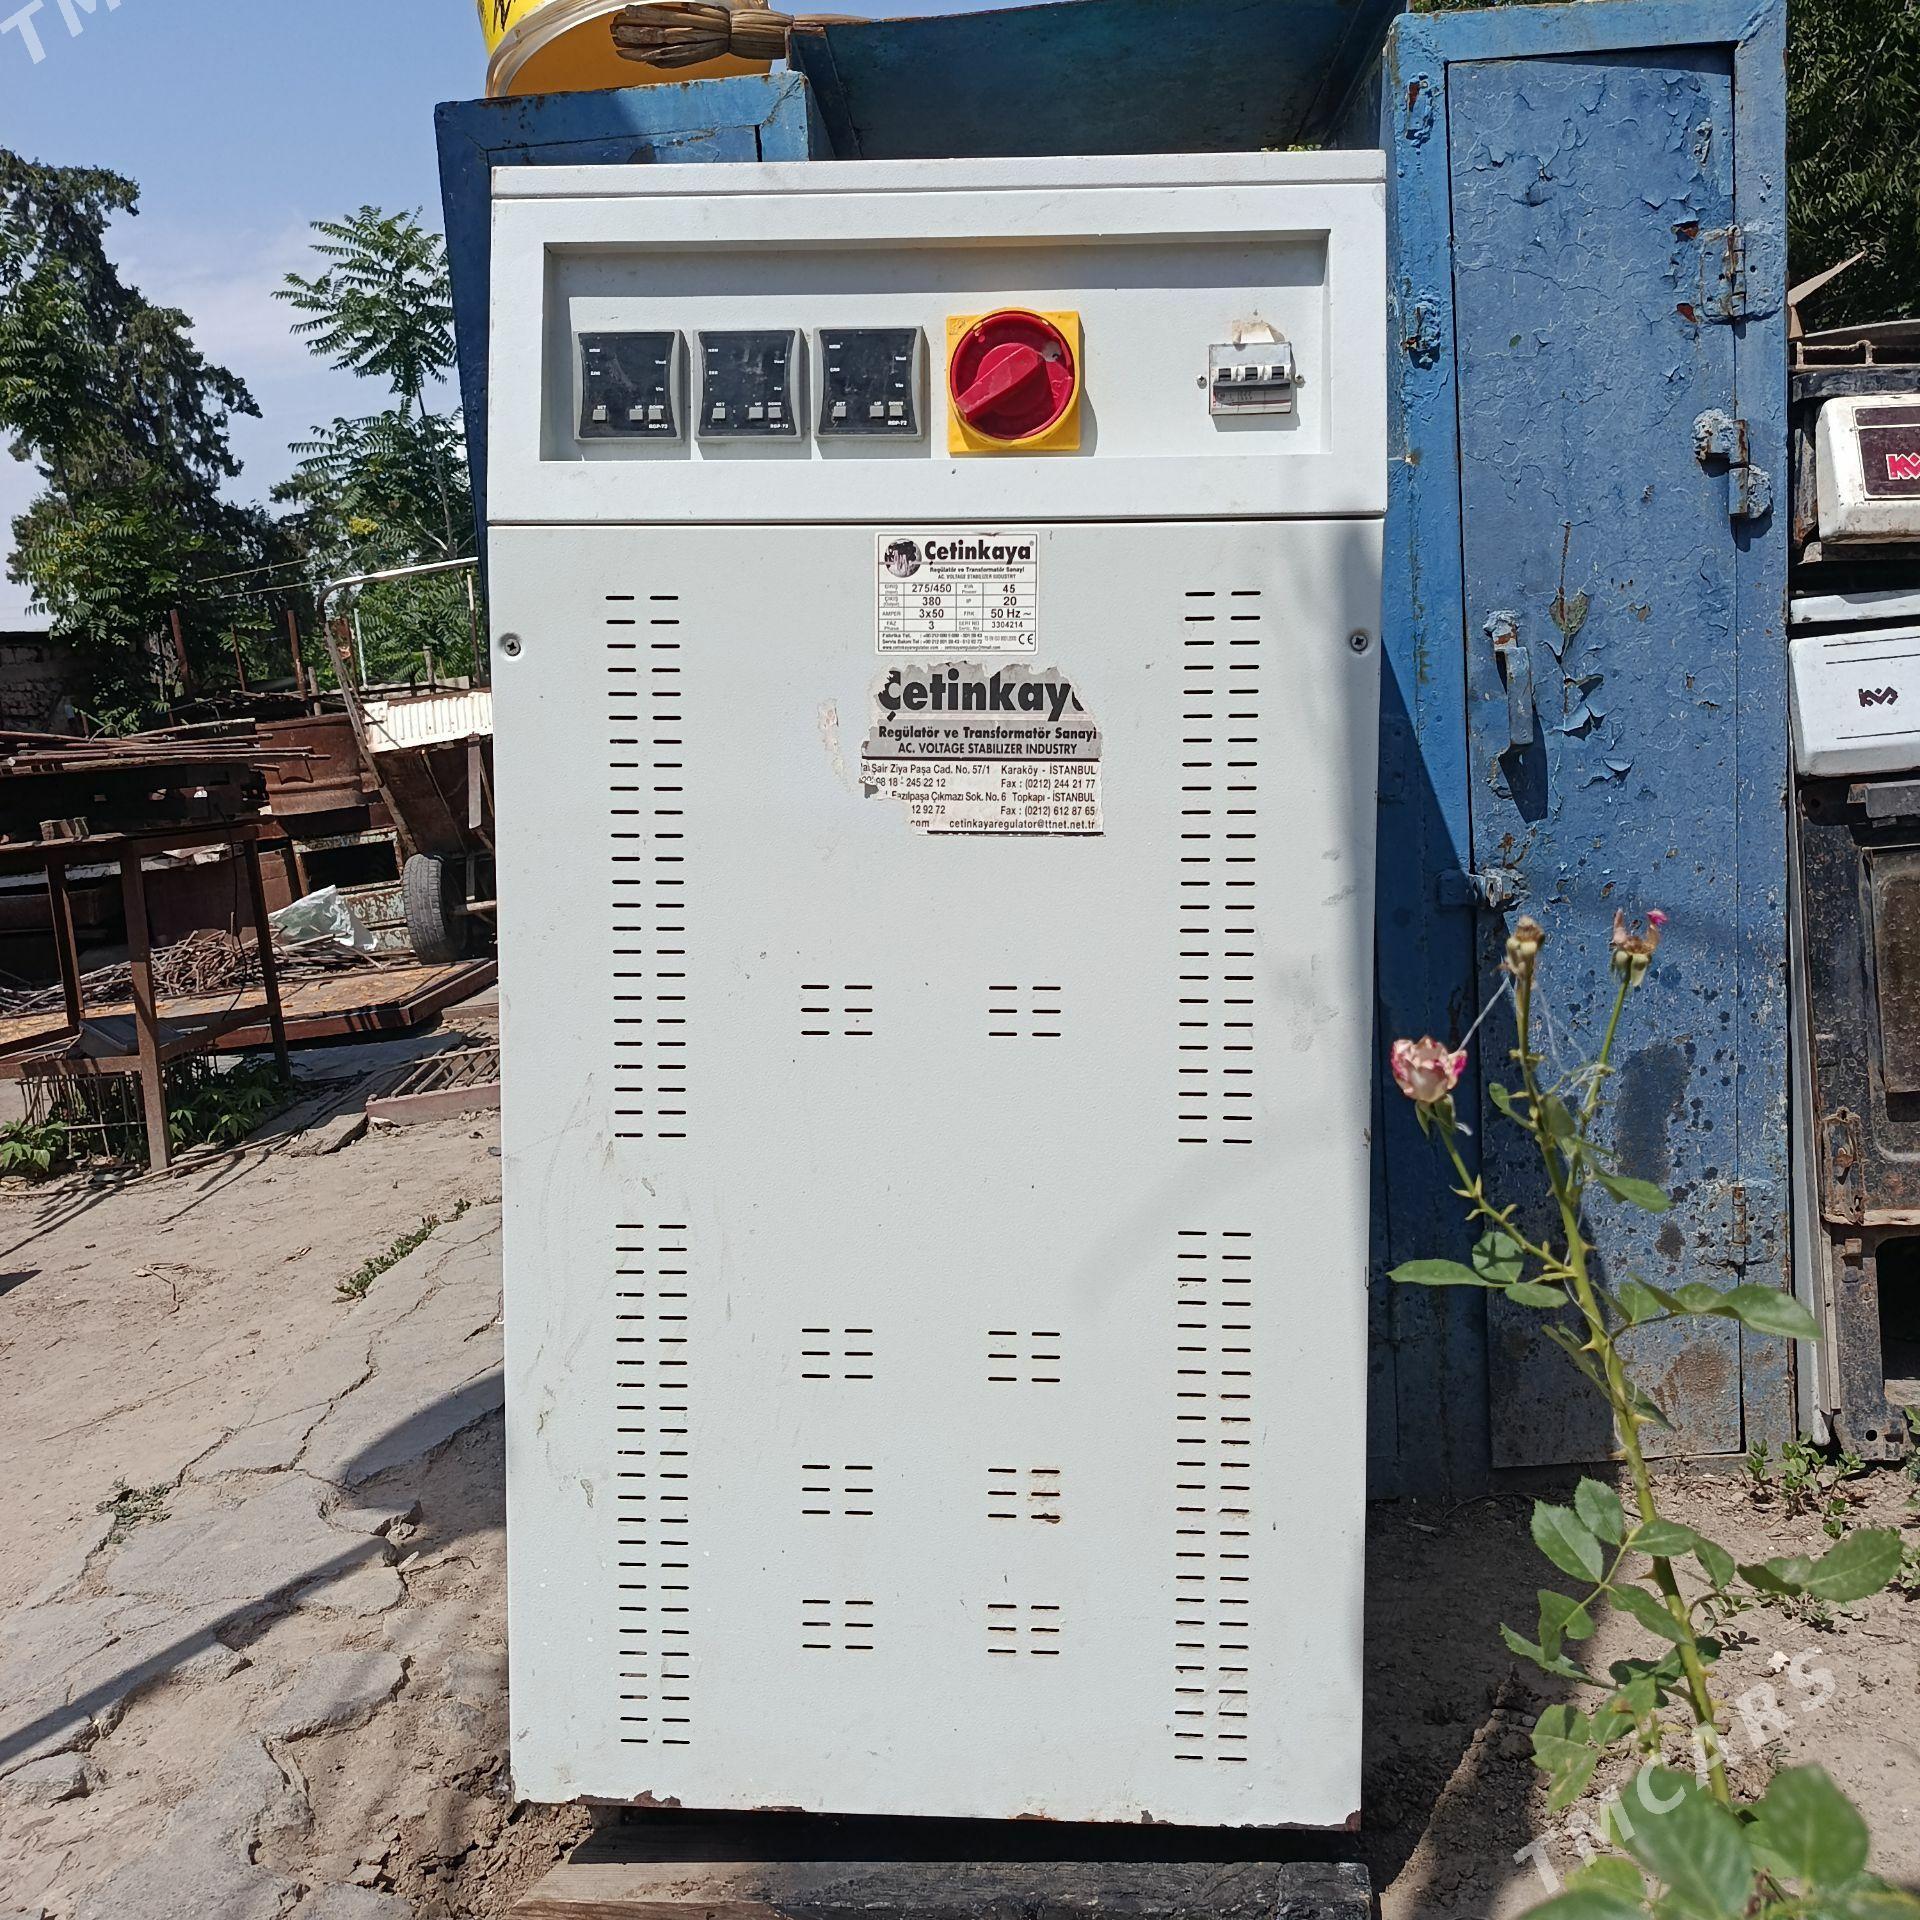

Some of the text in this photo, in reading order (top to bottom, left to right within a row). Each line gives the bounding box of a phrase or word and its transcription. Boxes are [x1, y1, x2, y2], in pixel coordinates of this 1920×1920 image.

[925, 539, 1031, 565] Çetinkaya
[912, 584, 951, 592] 275/450
[1003, 584, 1015, 593] 45
[923, 596, 941, 606] 380
[1004, 597, 1016, 605] 20
[919, 609, 944, 618] 3x50
[991, 609, 1020, 618] 50 Hz
[928, 621, 934, 630] 3
[878, 725, 1097, 743] Regülatör ve Transformatör Sanayi
[898, 743, 1077, 754] AC. VOLTAGE STABILIZER INDUSTRY
[890, 764, 907, 775] Ziya
[910, 764, 931, 775] Paşa
[934, 765, 953, 774] Cad.
[956, 765, 970, 774] No.
[973, 765, 990, 774] 57/1
[1001, 765, 1038, 776] Karaköy
[1050, 763, 1096, 775] İSTANBUL
[889, 778, 898, 786] 18
[907, 778, 921, 787] 245
[924, 778, 933, 787] 22
[937, 778, 946, 787] 12
[1001, 779, 1016, 788] Fax
[1025, 779, 1050, 790] (0212)
[1054, 779, 1069, 788] 244
[1073, 779, 1082, 788] 21
[1086, 779, 1095, 788] 77
[931, 792, 963, 802] Çıkmazı
[966, 792, 983, 801] Sok.
[986, 792, 999, 801] No.
[1001, 792, 1006, 801] 6
[1012, 792, 1045, 803] Topkapı
[1053, 790, 1095, 802] İSTANBUL
[923, 805, 933, 814] 92
[936, 805, 945, 814] 72
[1001, 806, 1016, 815] Fax
[1025, 806, 1050, 817] (0212)
[1054, 807, 1069, 815] 612
[1072, 807, 1081, 815] 87
[1085, 807, 1095, 815] 65
[950, 819, 1095, 830] cetinkayaregulator@ttnet.net.tr
